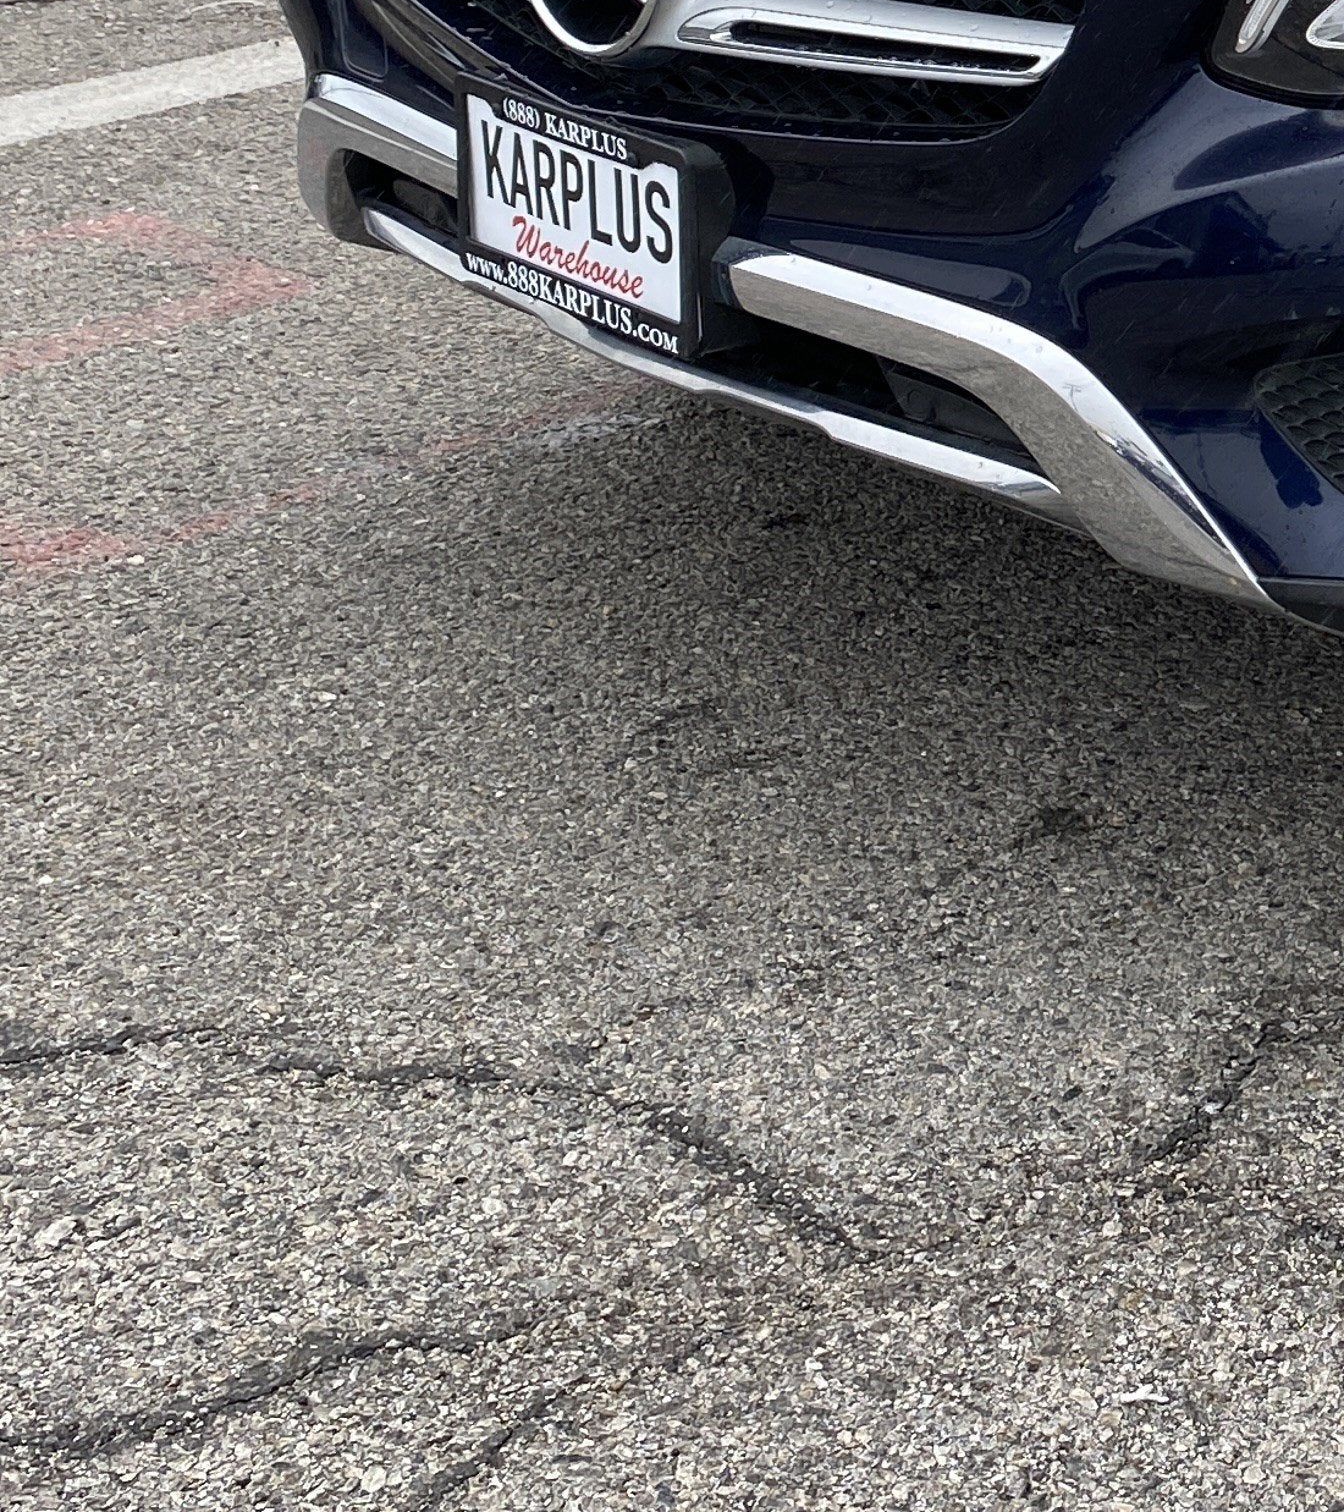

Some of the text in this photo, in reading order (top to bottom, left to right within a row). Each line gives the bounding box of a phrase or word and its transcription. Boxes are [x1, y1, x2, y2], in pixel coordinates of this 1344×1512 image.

[503, 97, 628, 161] (888) KARPLUS
[481, 119, 674, 264] KARPLUS
[511, 215, 645, 300] Warehouse
